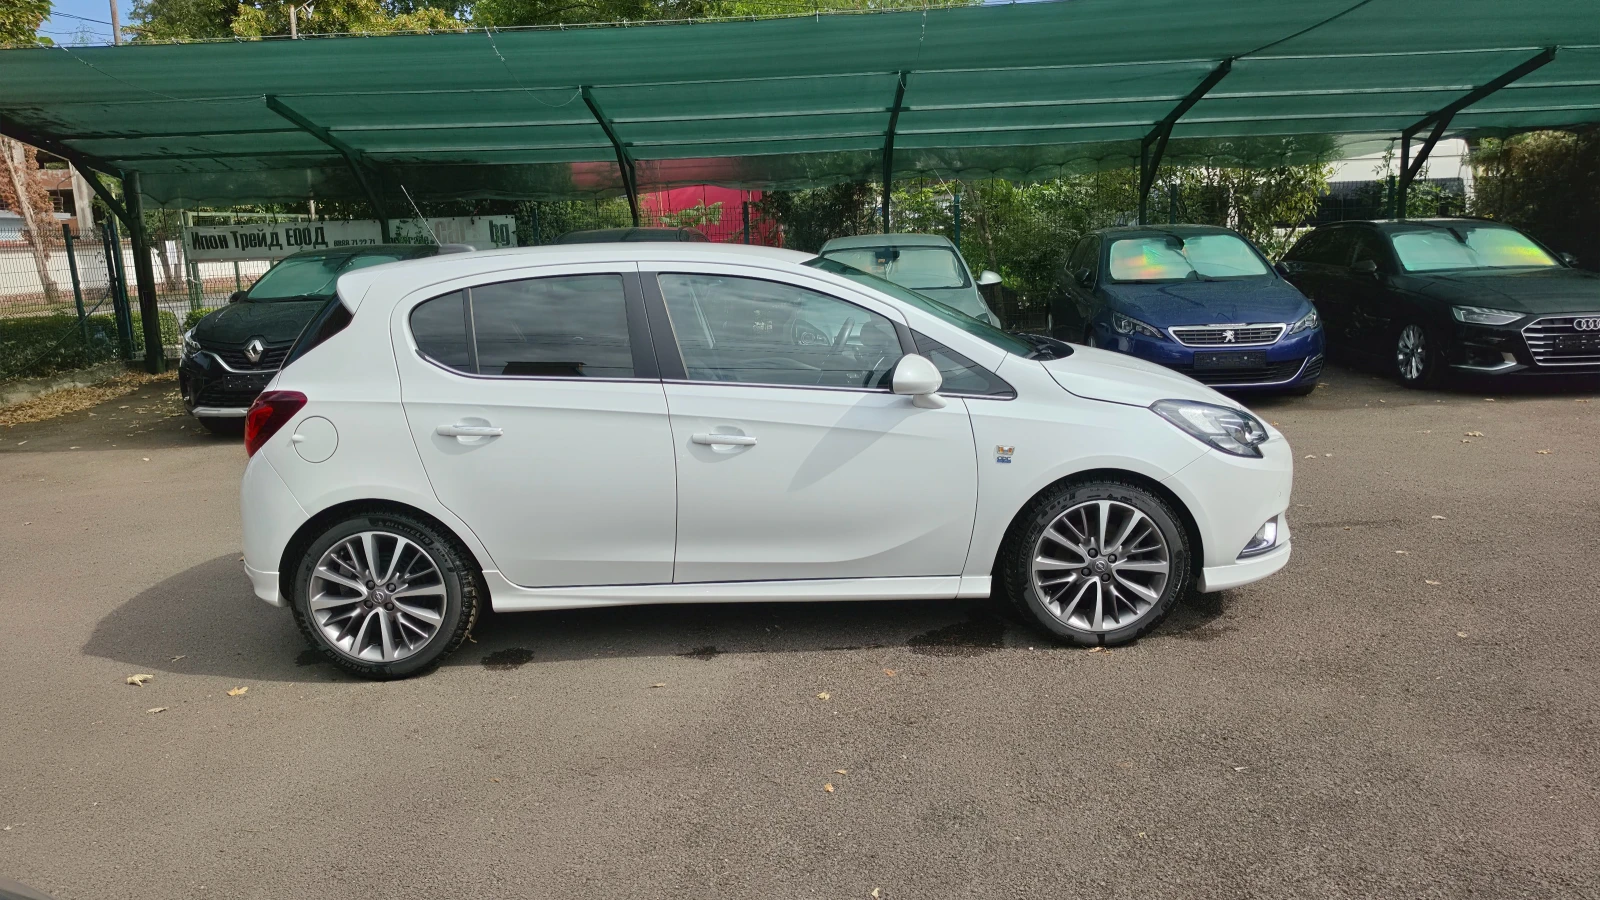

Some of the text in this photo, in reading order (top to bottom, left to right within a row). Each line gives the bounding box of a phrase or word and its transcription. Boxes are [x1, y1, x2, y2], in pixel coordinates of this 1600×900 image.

[191, 227, 329, 251] Ипон Трейд ЕООД
[385, 521, 432, 544] MICHELIN
